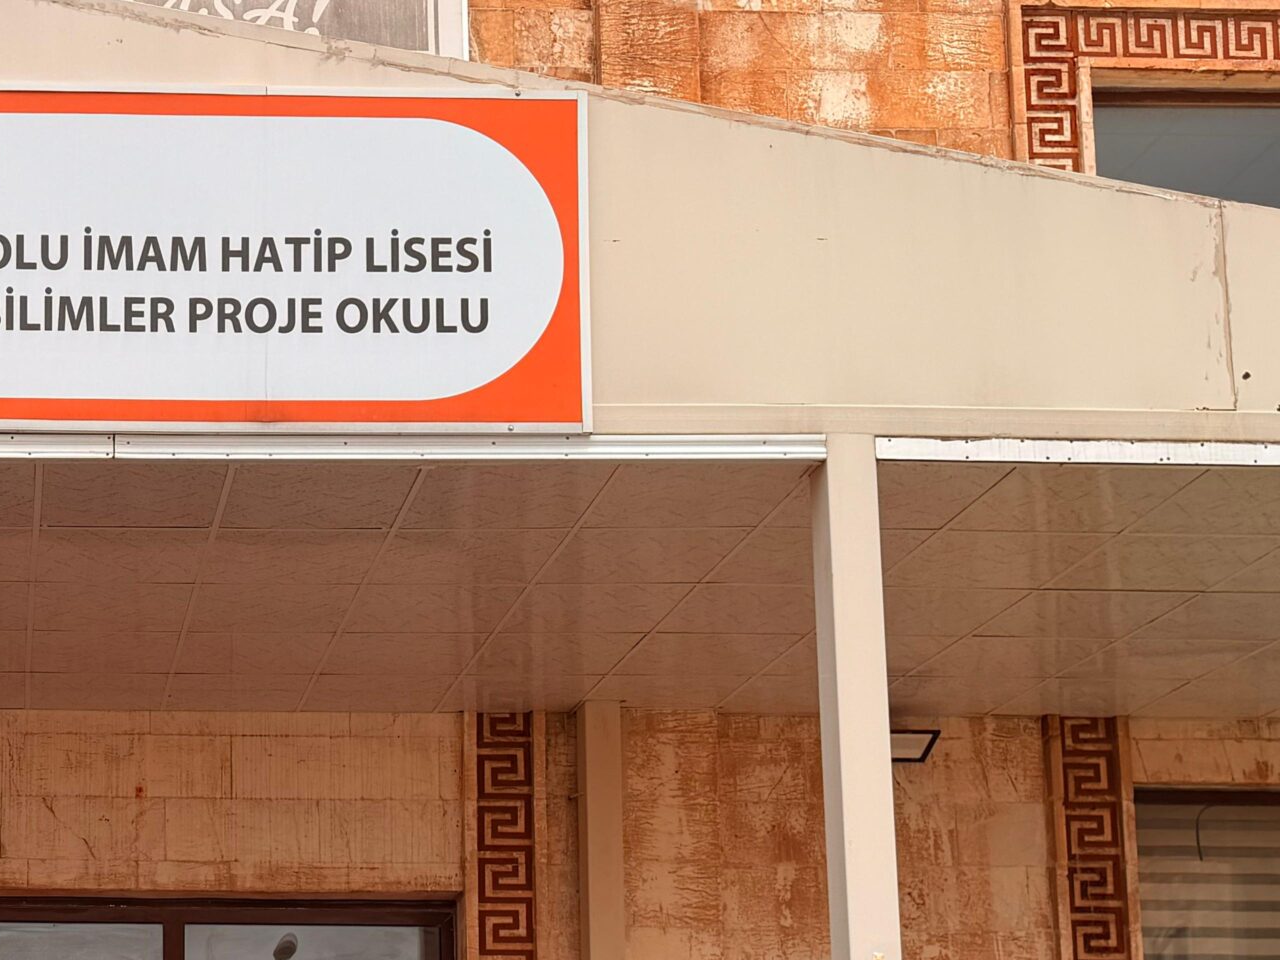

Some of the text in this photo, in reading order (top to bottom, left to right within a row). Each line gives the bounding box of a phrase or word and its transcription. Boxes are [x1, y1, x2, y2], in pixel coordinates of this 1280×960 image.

[84, 227, 206, 271] İMAM
[222, 229, 352, 272] HATİP
[366, 229, 491, 272] LİSESİ
[189, 298, 323, 333] PROJE
[336, 298, 488, 333] OKULU
